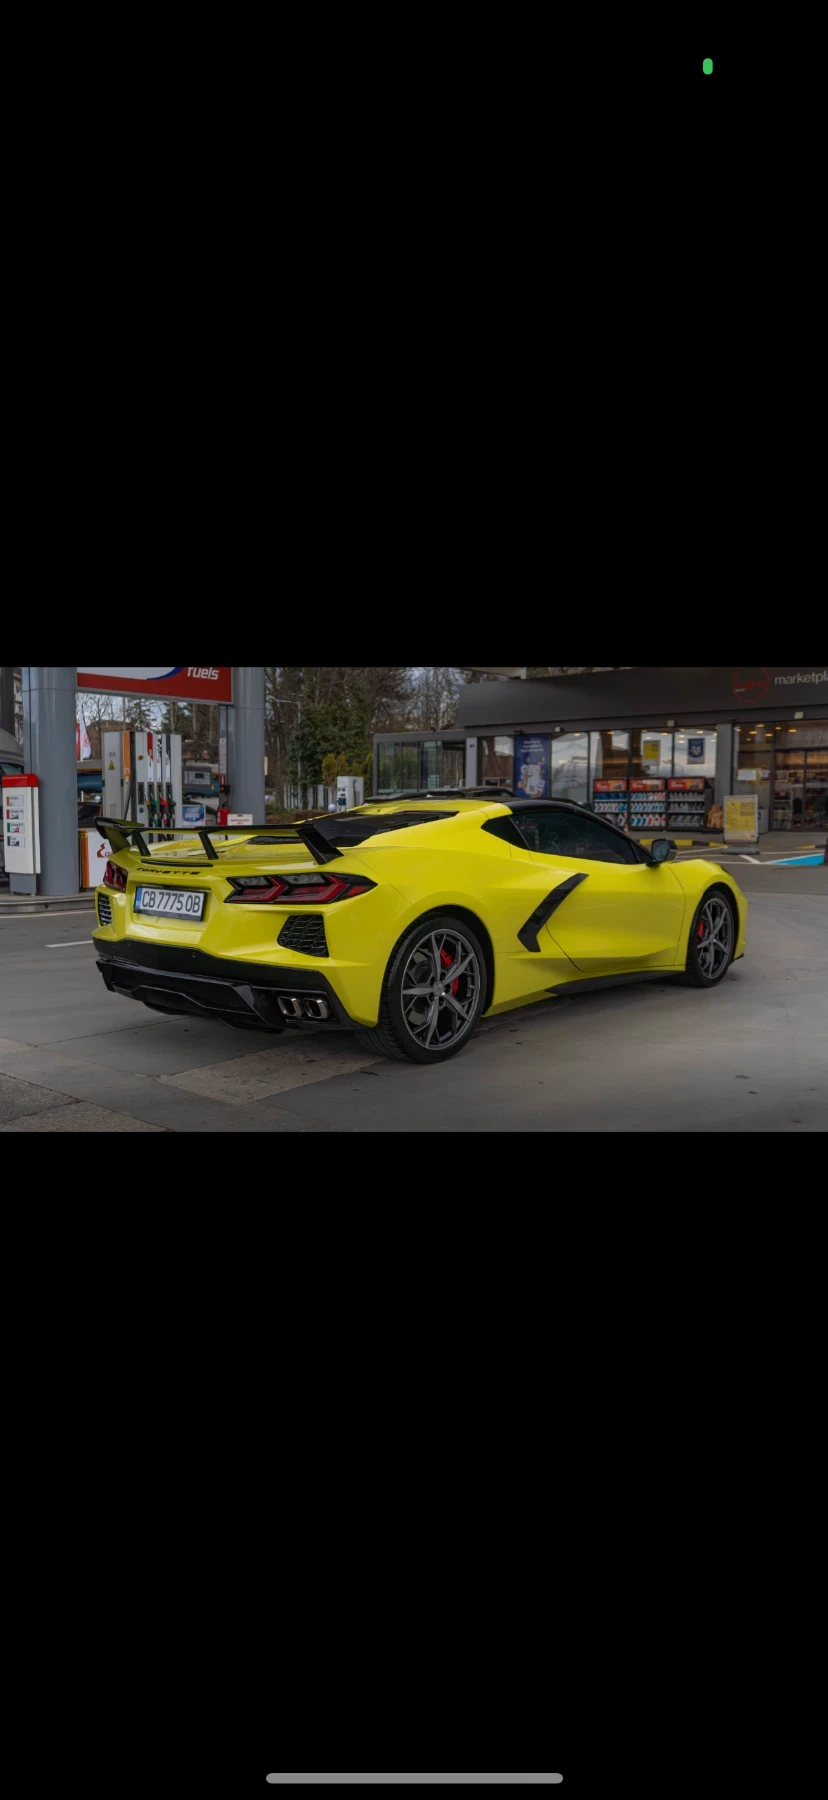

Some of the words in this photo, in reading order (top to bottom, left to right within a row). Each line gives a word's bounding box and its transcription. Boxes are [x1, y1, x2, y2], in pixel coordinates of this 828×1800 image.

[187, 667, 219, 680] fuels
[136, 867, 201, 875] CORVETTE
[142, 890, 156, 908] CB
[157, 891, 184, 911] 7775
